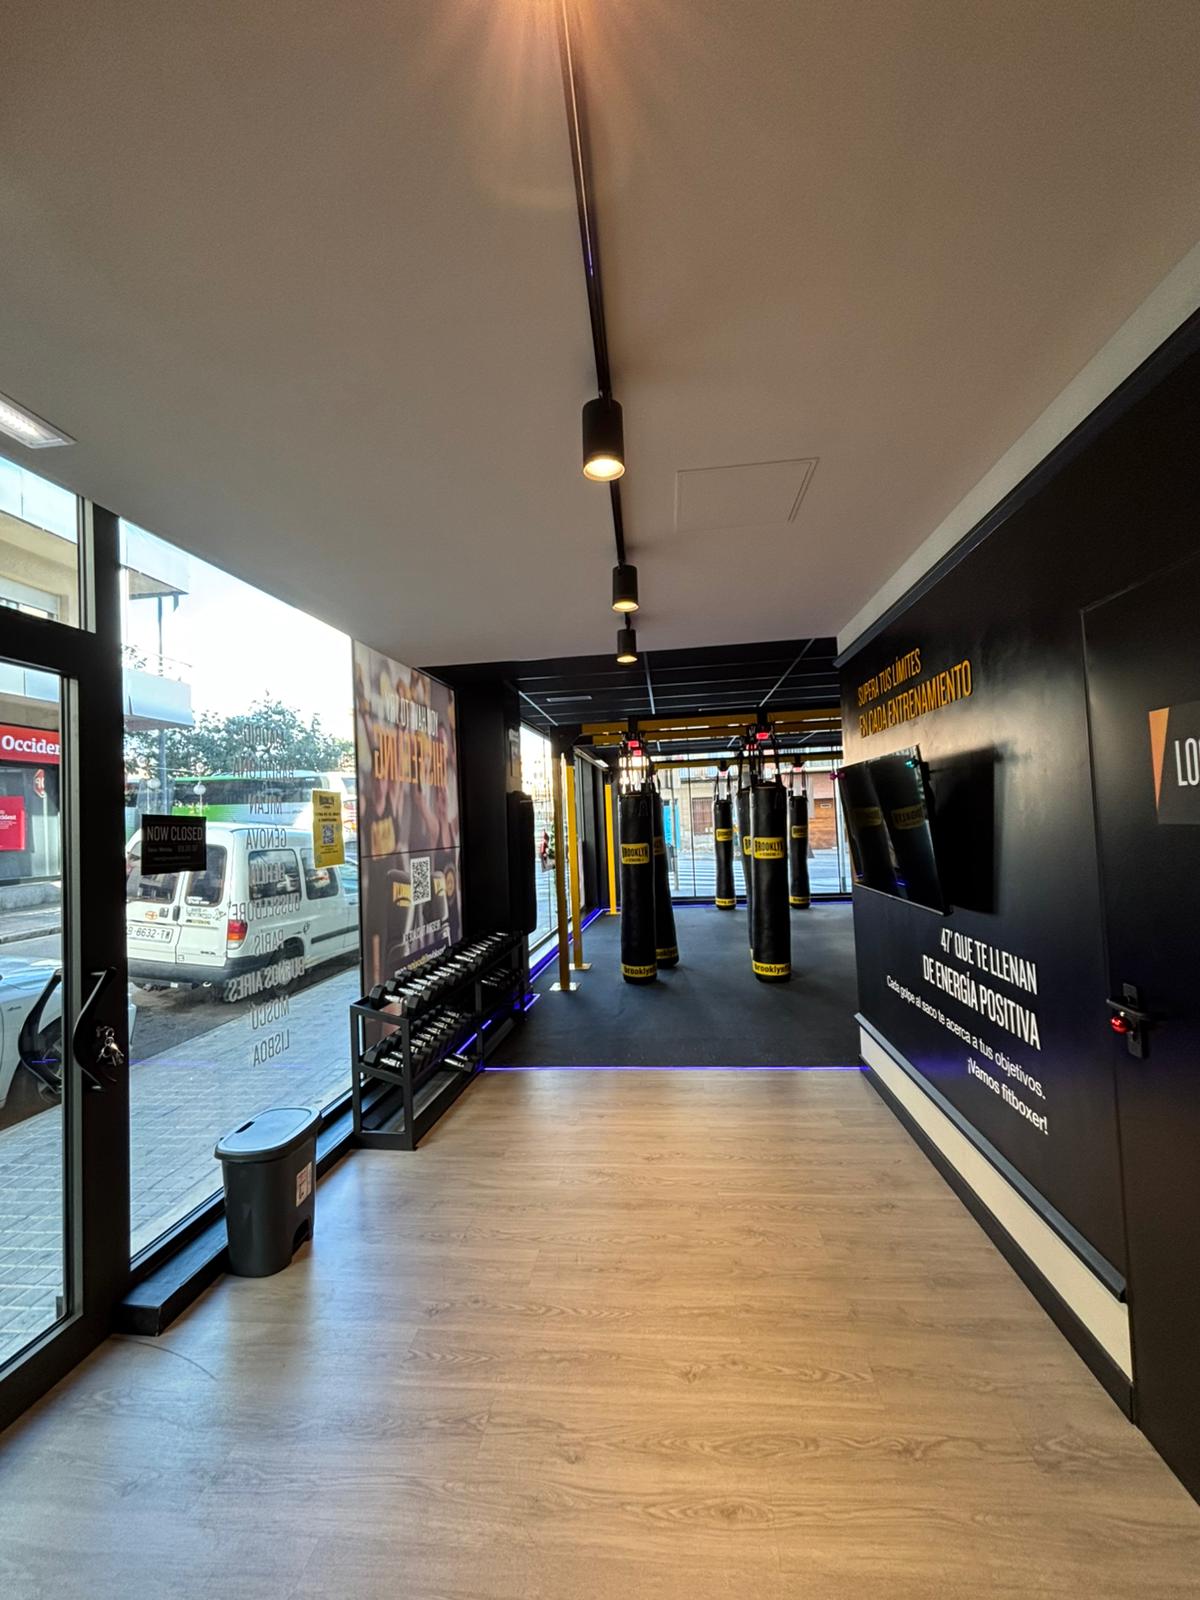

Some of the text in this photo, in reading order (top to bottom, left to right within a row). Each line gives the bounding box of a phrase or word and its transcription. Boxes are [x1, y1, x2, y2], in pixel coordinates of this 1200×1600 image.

[858, 647, 921, 707] SUPERA TUS LÍMITES
[860, 660, 972, 738] EN CADA ENTRENAMIENTO
[1174, 737, 1200, 787] LO
[146, 826, 203, 841] NOW CLOSED
[954, 932, 974, 965] QUE
[974, 940, 988, 972] TE
[990, 946, 1038, 995] LLENAN
[886, 975, 1046, 1100] Cada golpe al saco te acerca a tus objetivos.
[922, 954, 1041, 1051] DE ENERGÍA POSITIVA
[967, 1057, 1048, 1135] ¡Vamos fitboxer!
